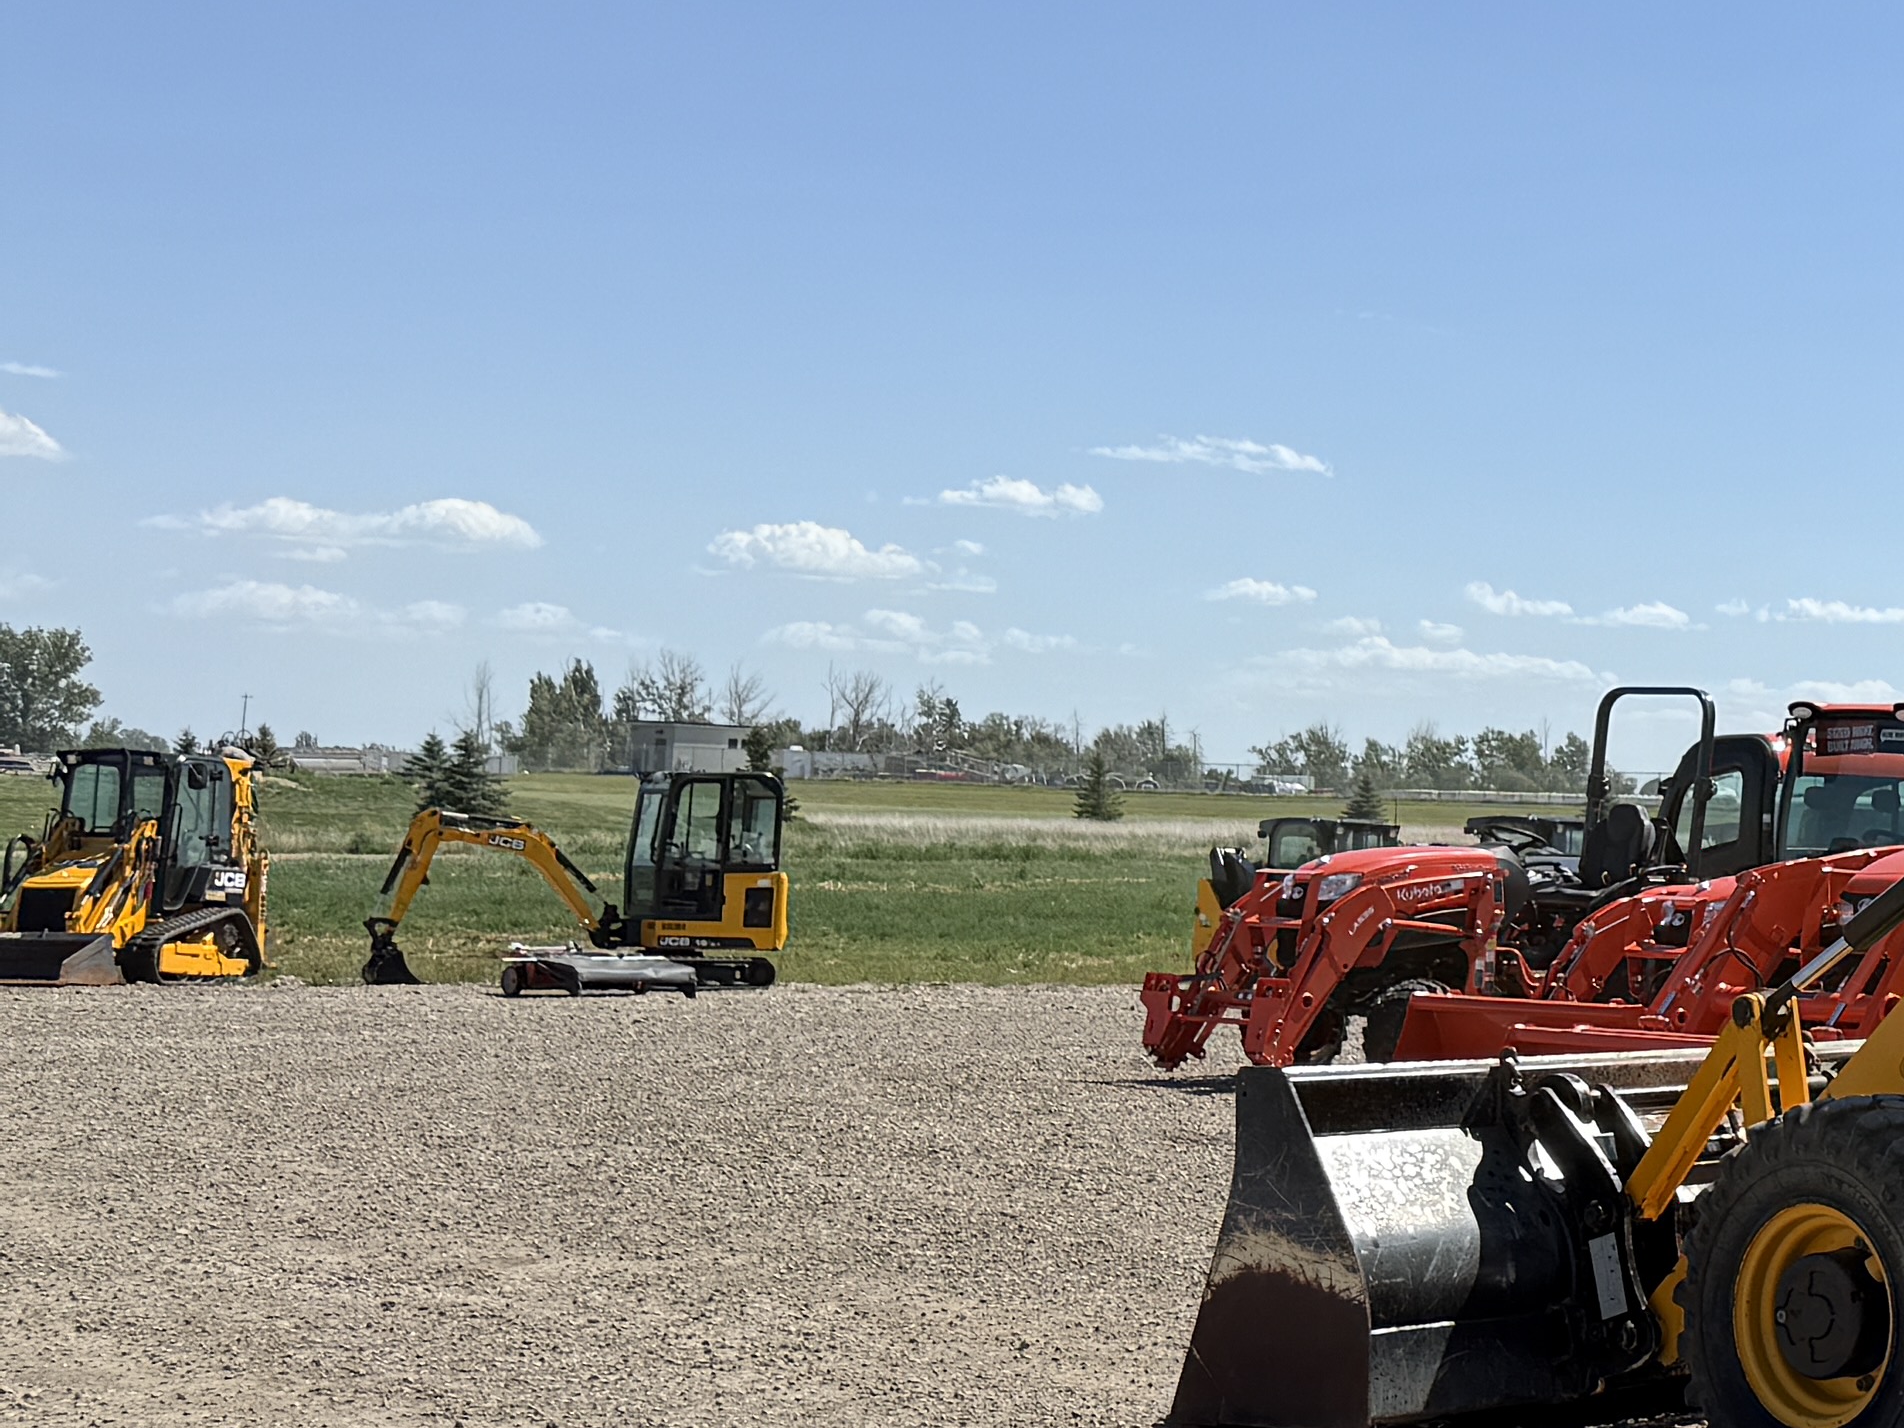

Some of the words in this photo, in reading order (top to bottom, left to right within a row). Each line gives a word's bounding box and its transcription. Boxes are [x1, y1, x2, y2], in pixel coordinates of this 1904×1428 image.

[489, 835, 525, 850] JCB
[214, 871, 247, 888] JCB
[659, 936, 691, 947] JCB
